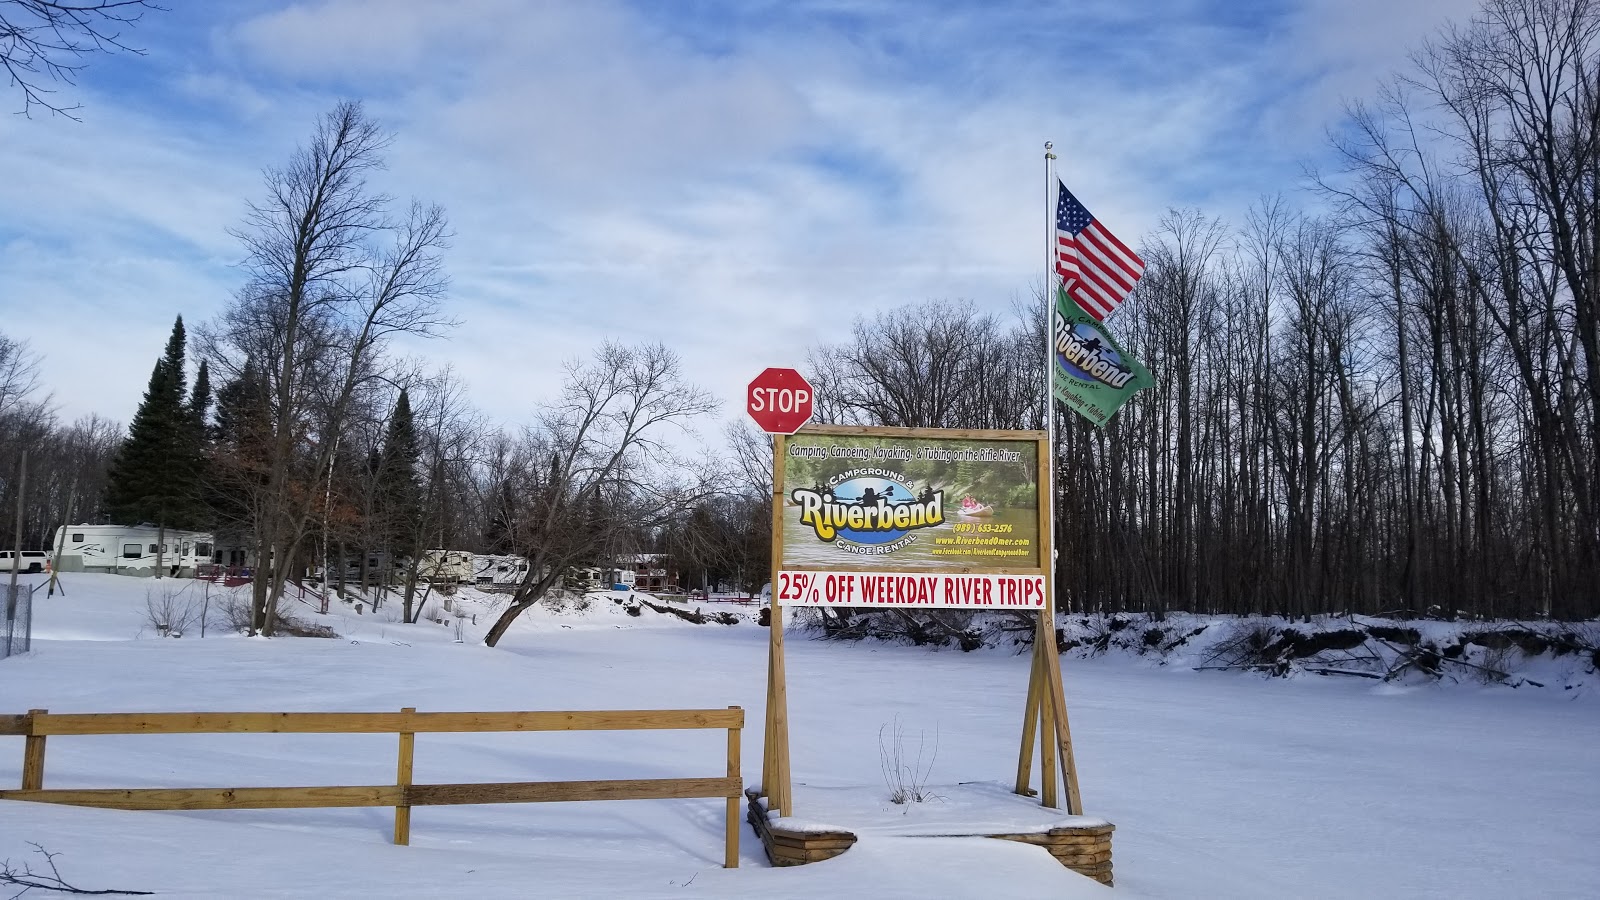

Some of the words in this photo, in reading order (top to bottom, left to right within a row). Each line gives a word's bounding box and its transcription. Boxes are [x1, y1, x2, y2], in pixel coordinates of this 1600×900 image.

[1068, 378, 1101, 390] RENTAL
[751, 387, 809, 413] STOP
[1087, 403, 1106, 422] Tubing
[789, 443, 828, 460] Camping,
[830, 444, 871, 461] Canoeing,
[873, 445, 912, 462] Kayaking,
[916, 447, 923, 459] &
[924, 447, 951, 463] Tubing
[953, 451, 963, 461] on
[965, 447, 978, 461] the
[979, 448, 998, 461] Rifle
[999, 448, 1020, 461] River
[829, 467, 905, 486] CAMPGROUND
[905, 480, 915, 489] &
[791, 487, 945, 542] Riverbend
[977, 524, 1012, 533] 653-2576
[836, 539, 873, 555] CANOE
[876, 534, 917, 555] RENTAL
[935, 536, 1030, 546] www.RiverbendOmer.com
[779, 573, 819, 603] 25%
[825, 574, 855, 603] OFF
[860, 575, 938, 604] WEEKDAY
[944, 577, 992, 605] RIVER
[998, 578, 1043, 606] TRIPS
